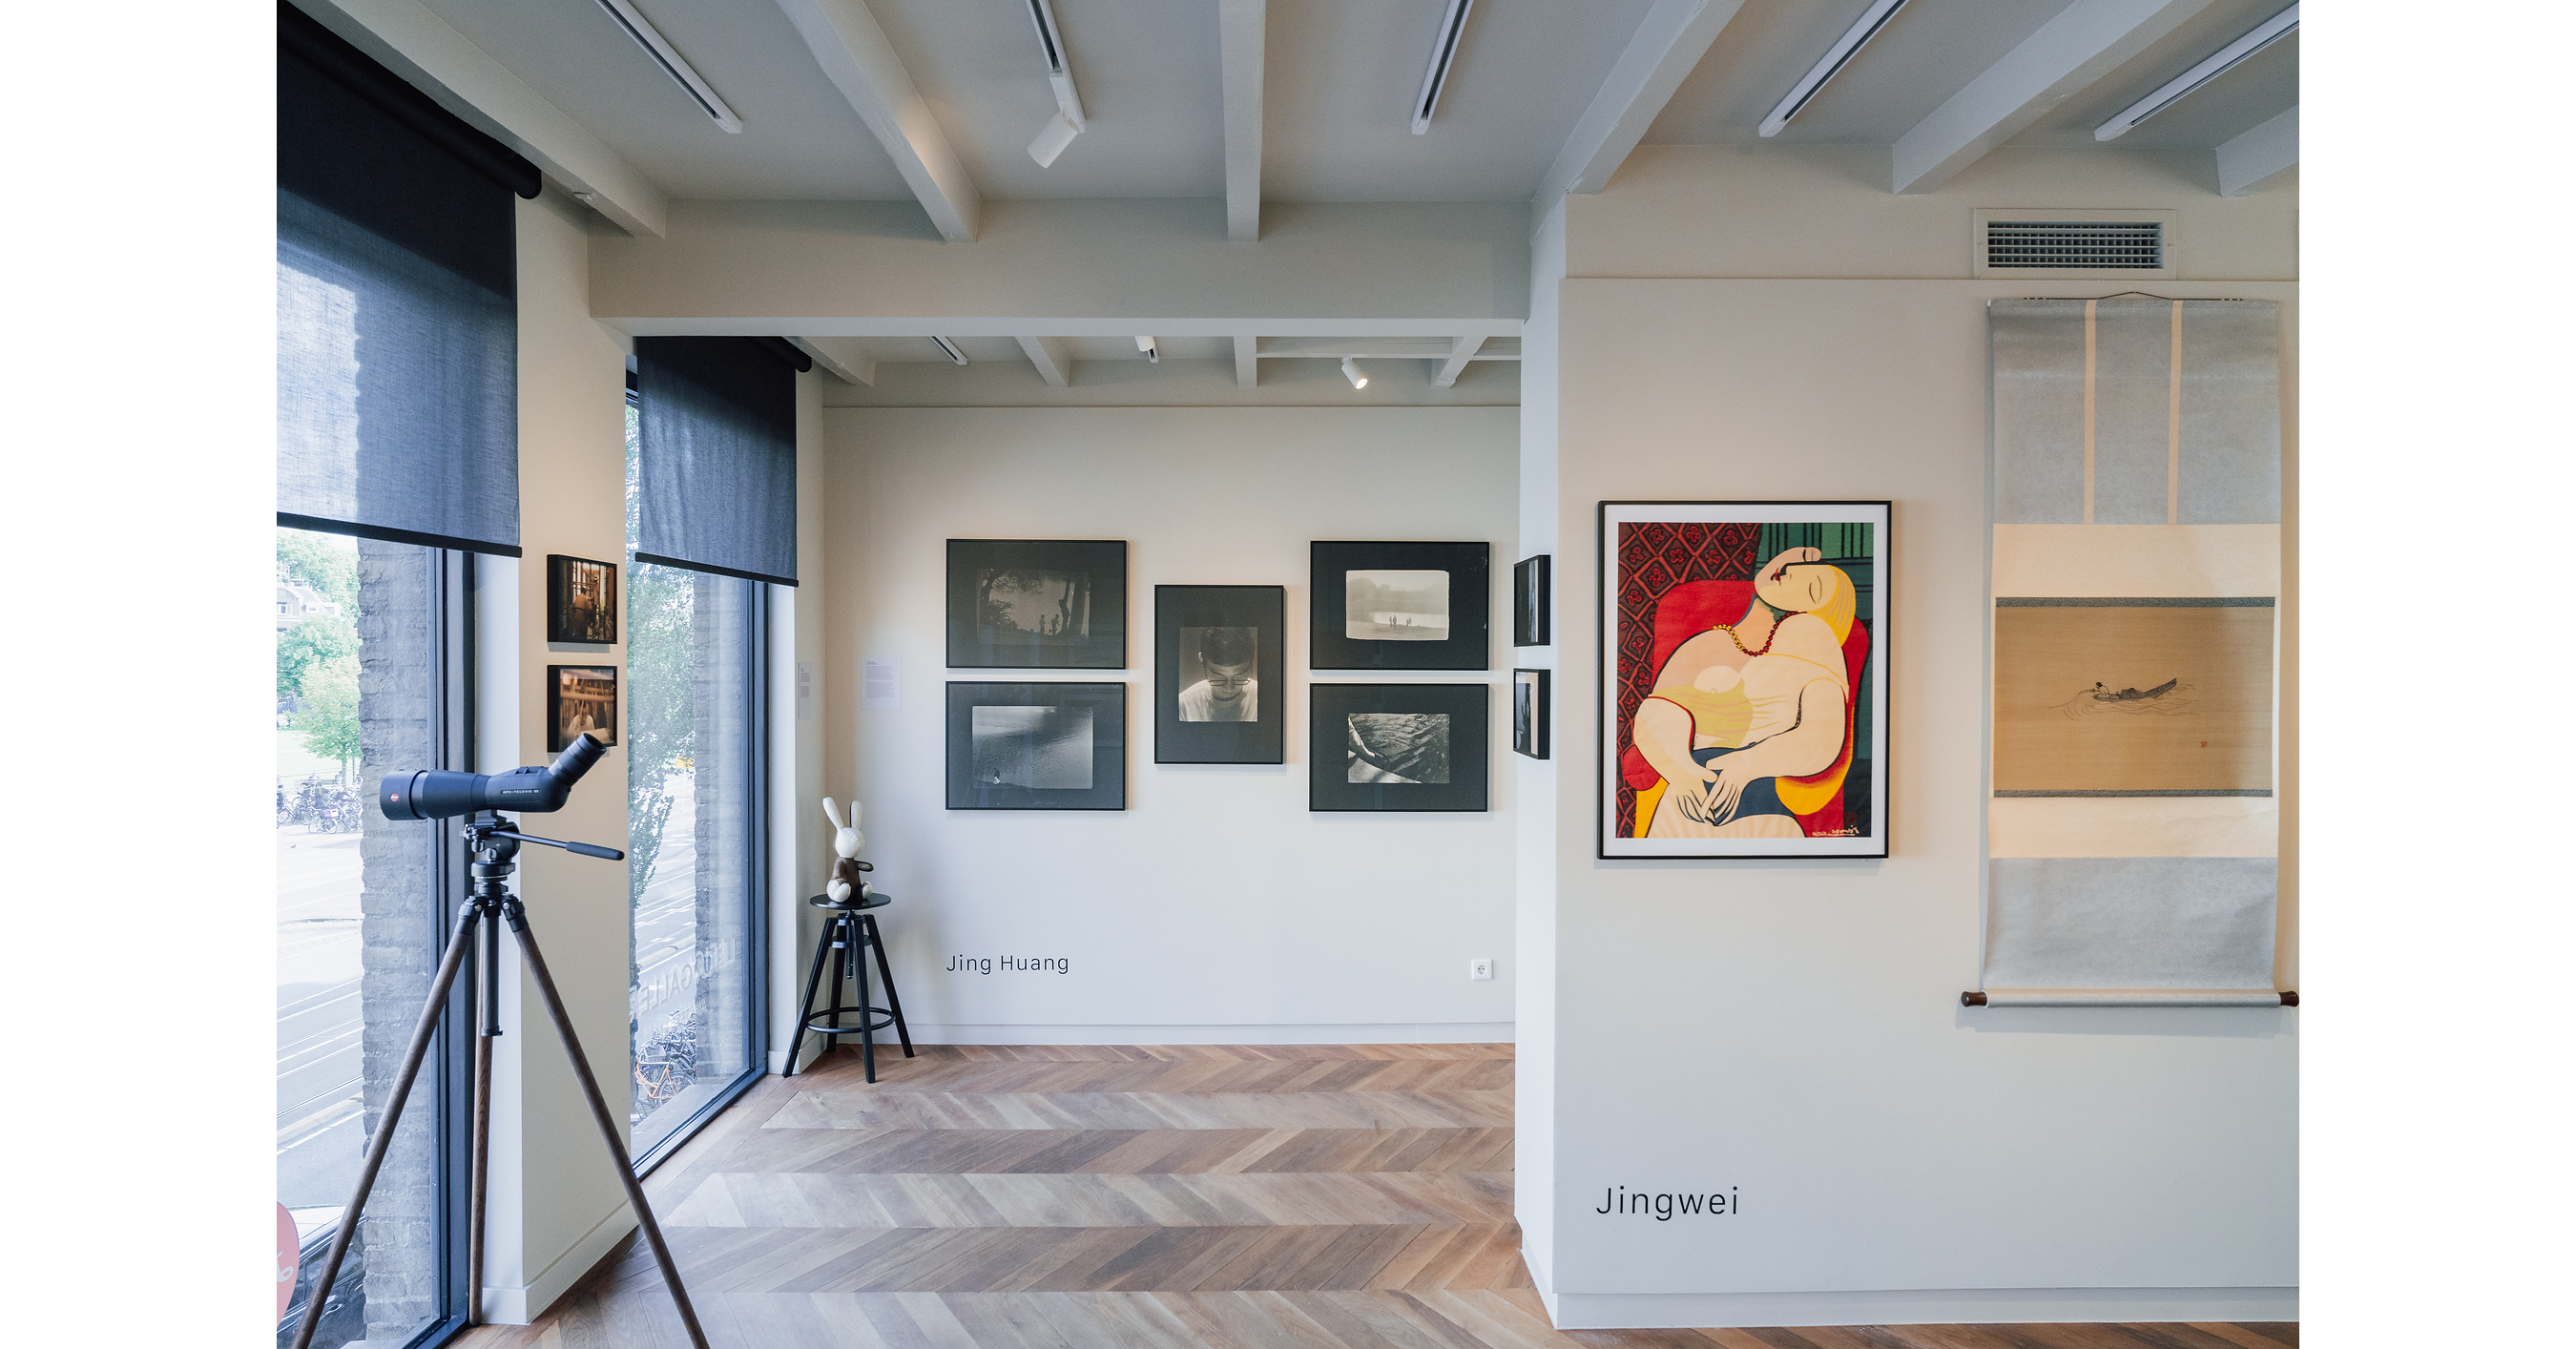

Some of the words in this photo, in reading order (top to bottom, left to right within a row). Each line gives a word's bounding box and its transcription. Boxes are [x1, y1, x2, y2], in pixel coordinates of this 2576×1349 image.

[946, 954, 991, 975] Jing
[1001, 955, 1069, 975] Huang
[1595, 1185, 1738, 1222] Jingwei
